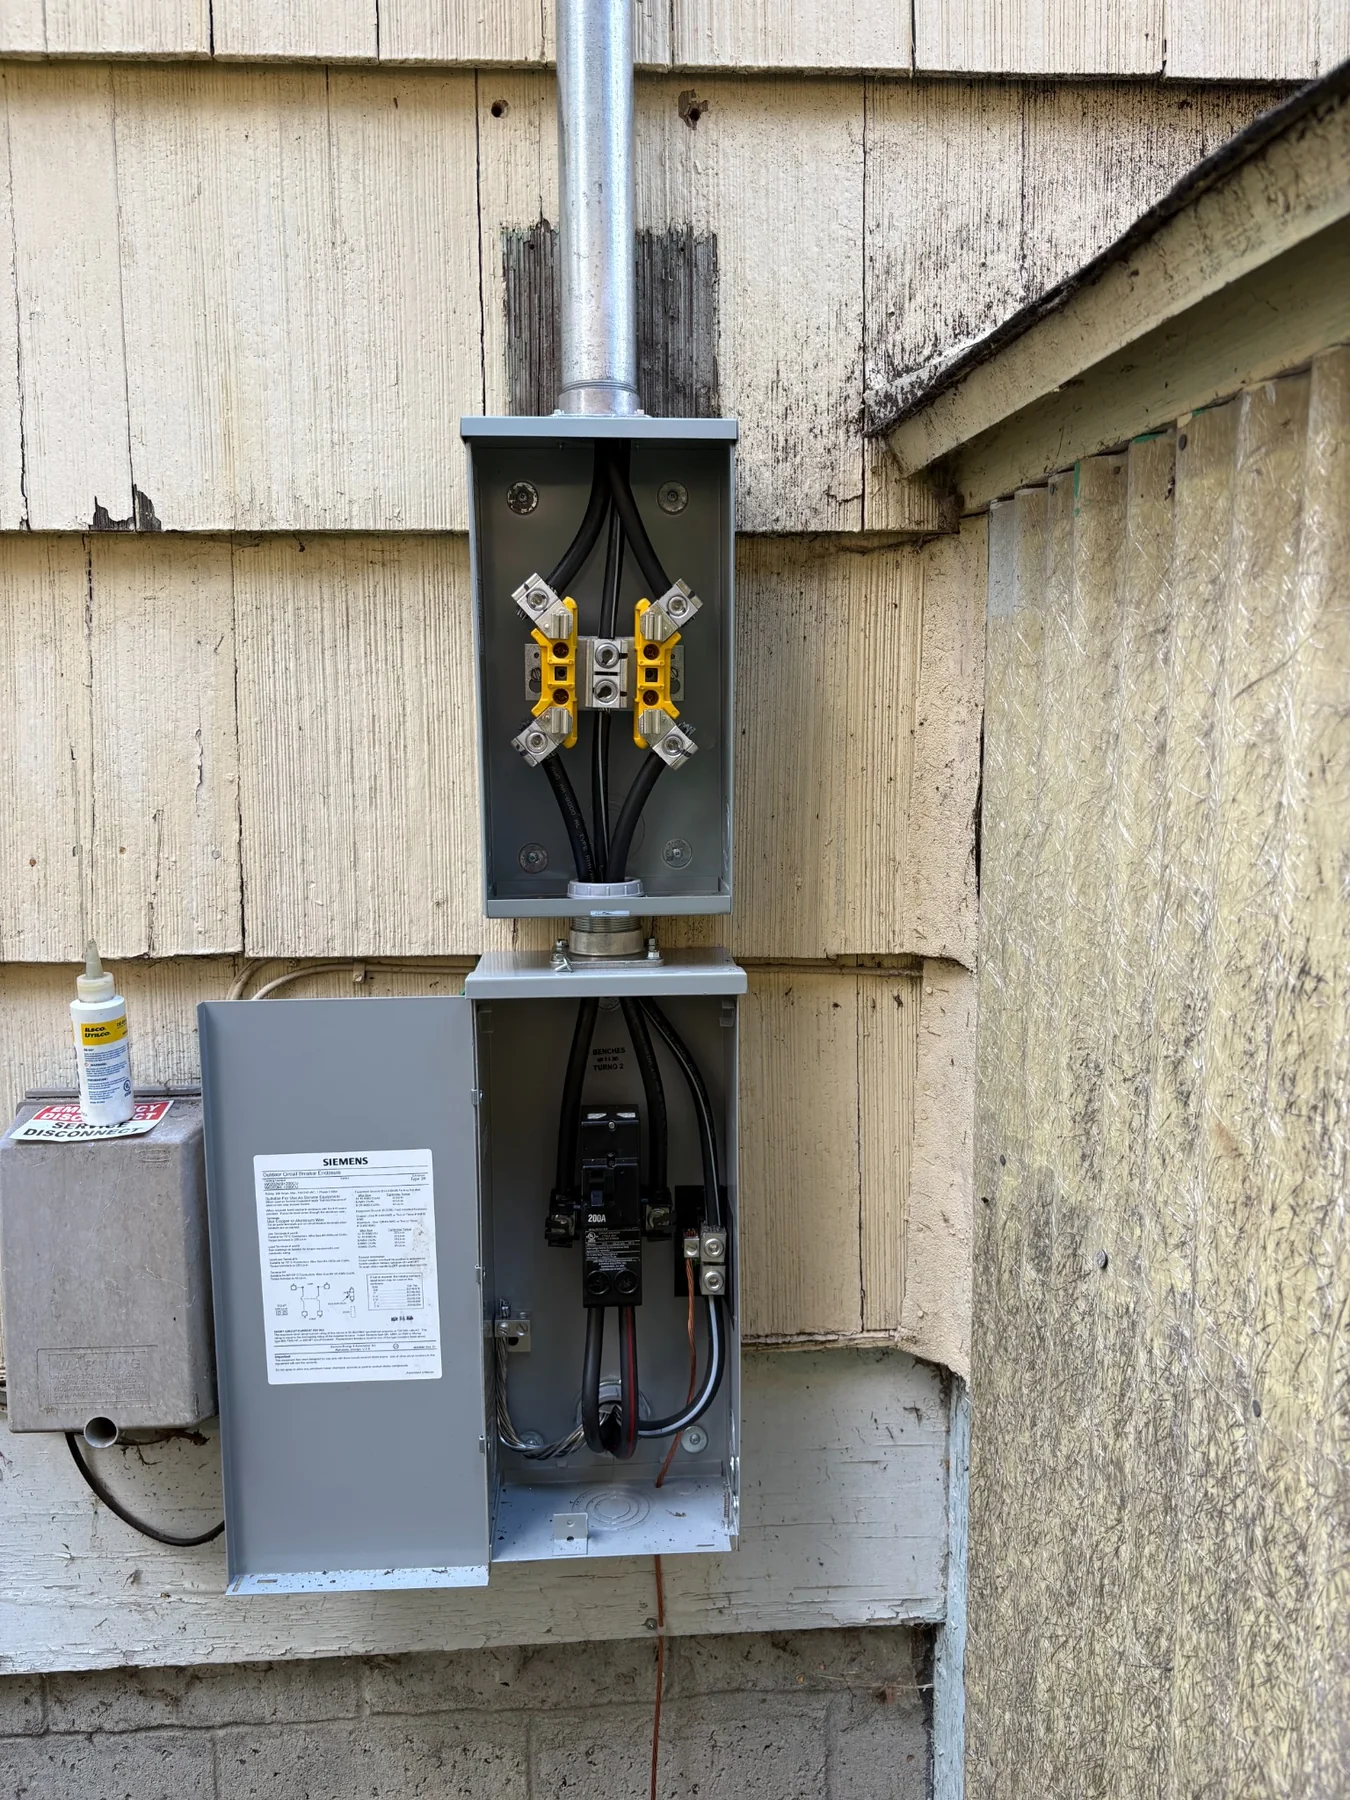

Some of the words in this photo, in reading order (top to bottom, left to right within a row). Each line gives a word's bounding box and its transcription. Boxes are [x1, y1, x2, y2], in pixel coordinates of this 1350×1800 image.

[23, 1126, 143, 1138] DISCONNECT
[322, 1156, 369, 1167] SIEMENS
[587, 1213, 607, 1223] 200A
